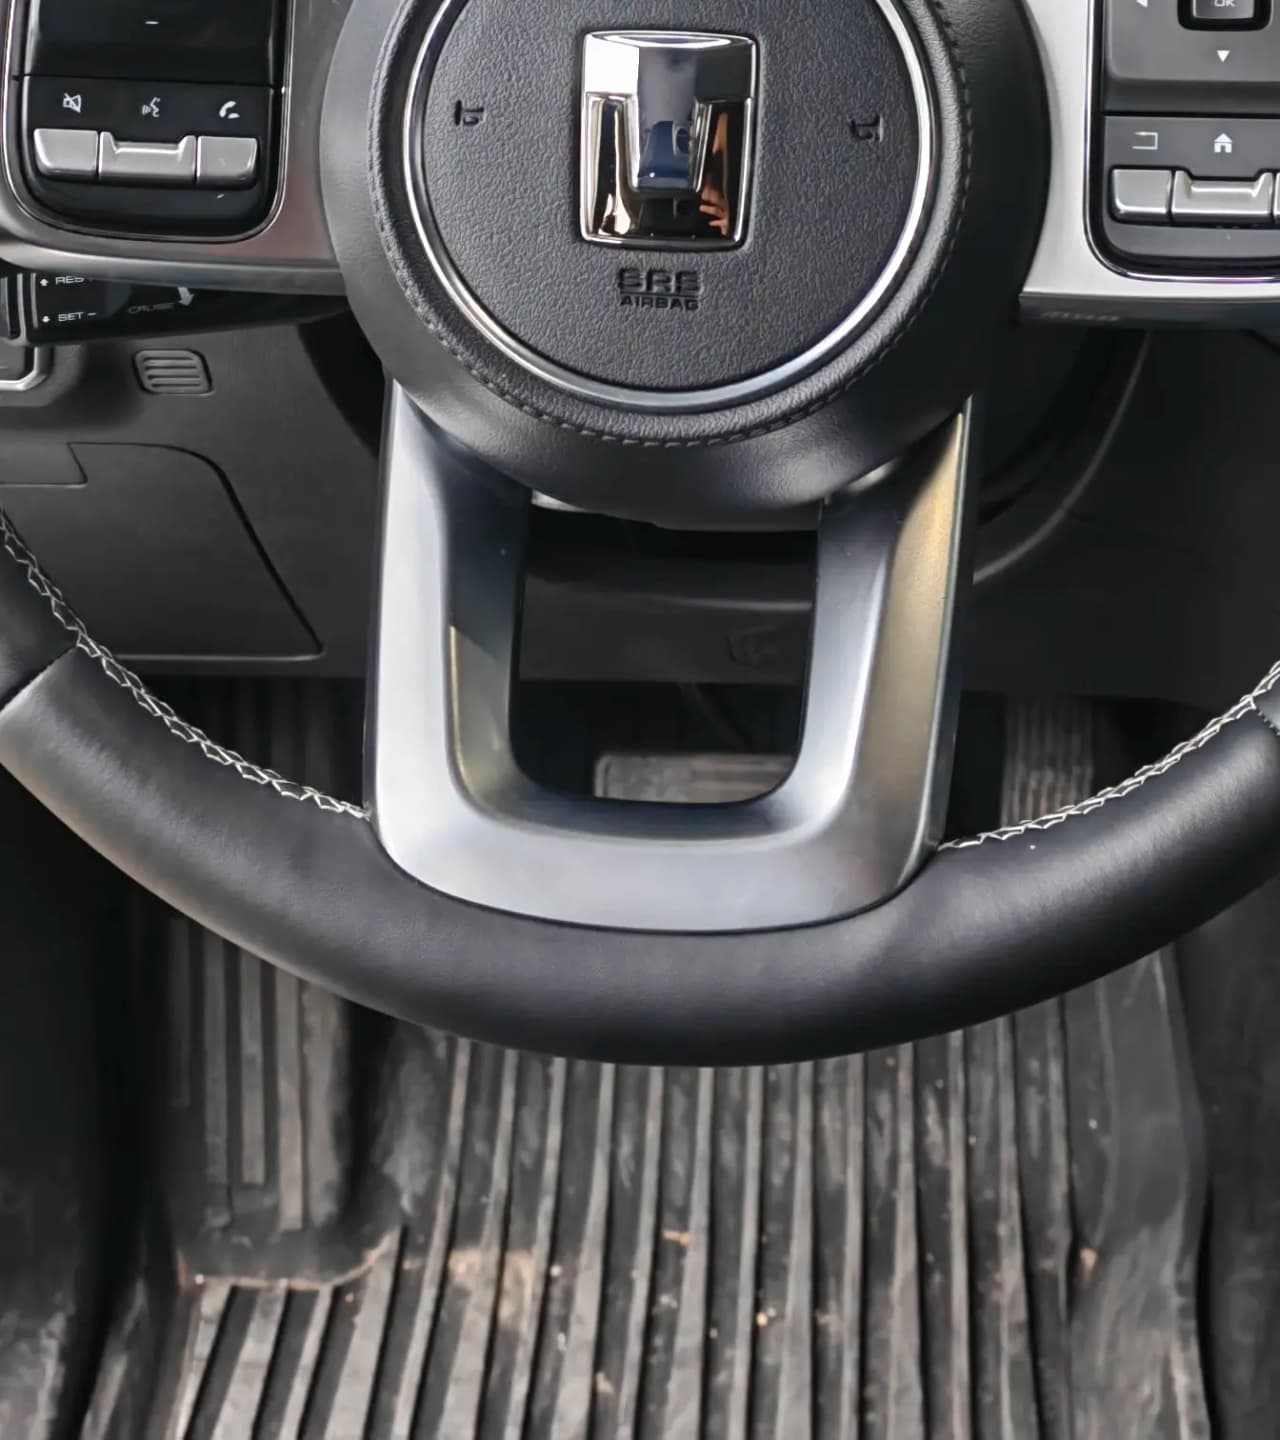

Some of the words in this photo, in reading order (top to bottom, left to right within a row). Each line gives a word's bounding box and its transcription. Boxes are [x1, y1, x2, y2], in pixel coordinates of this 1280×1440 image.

[619, 268, 700, 293] SRS
[620, 295, 699, 311] AIRBAG
[57, 311, 85, 322] SET
